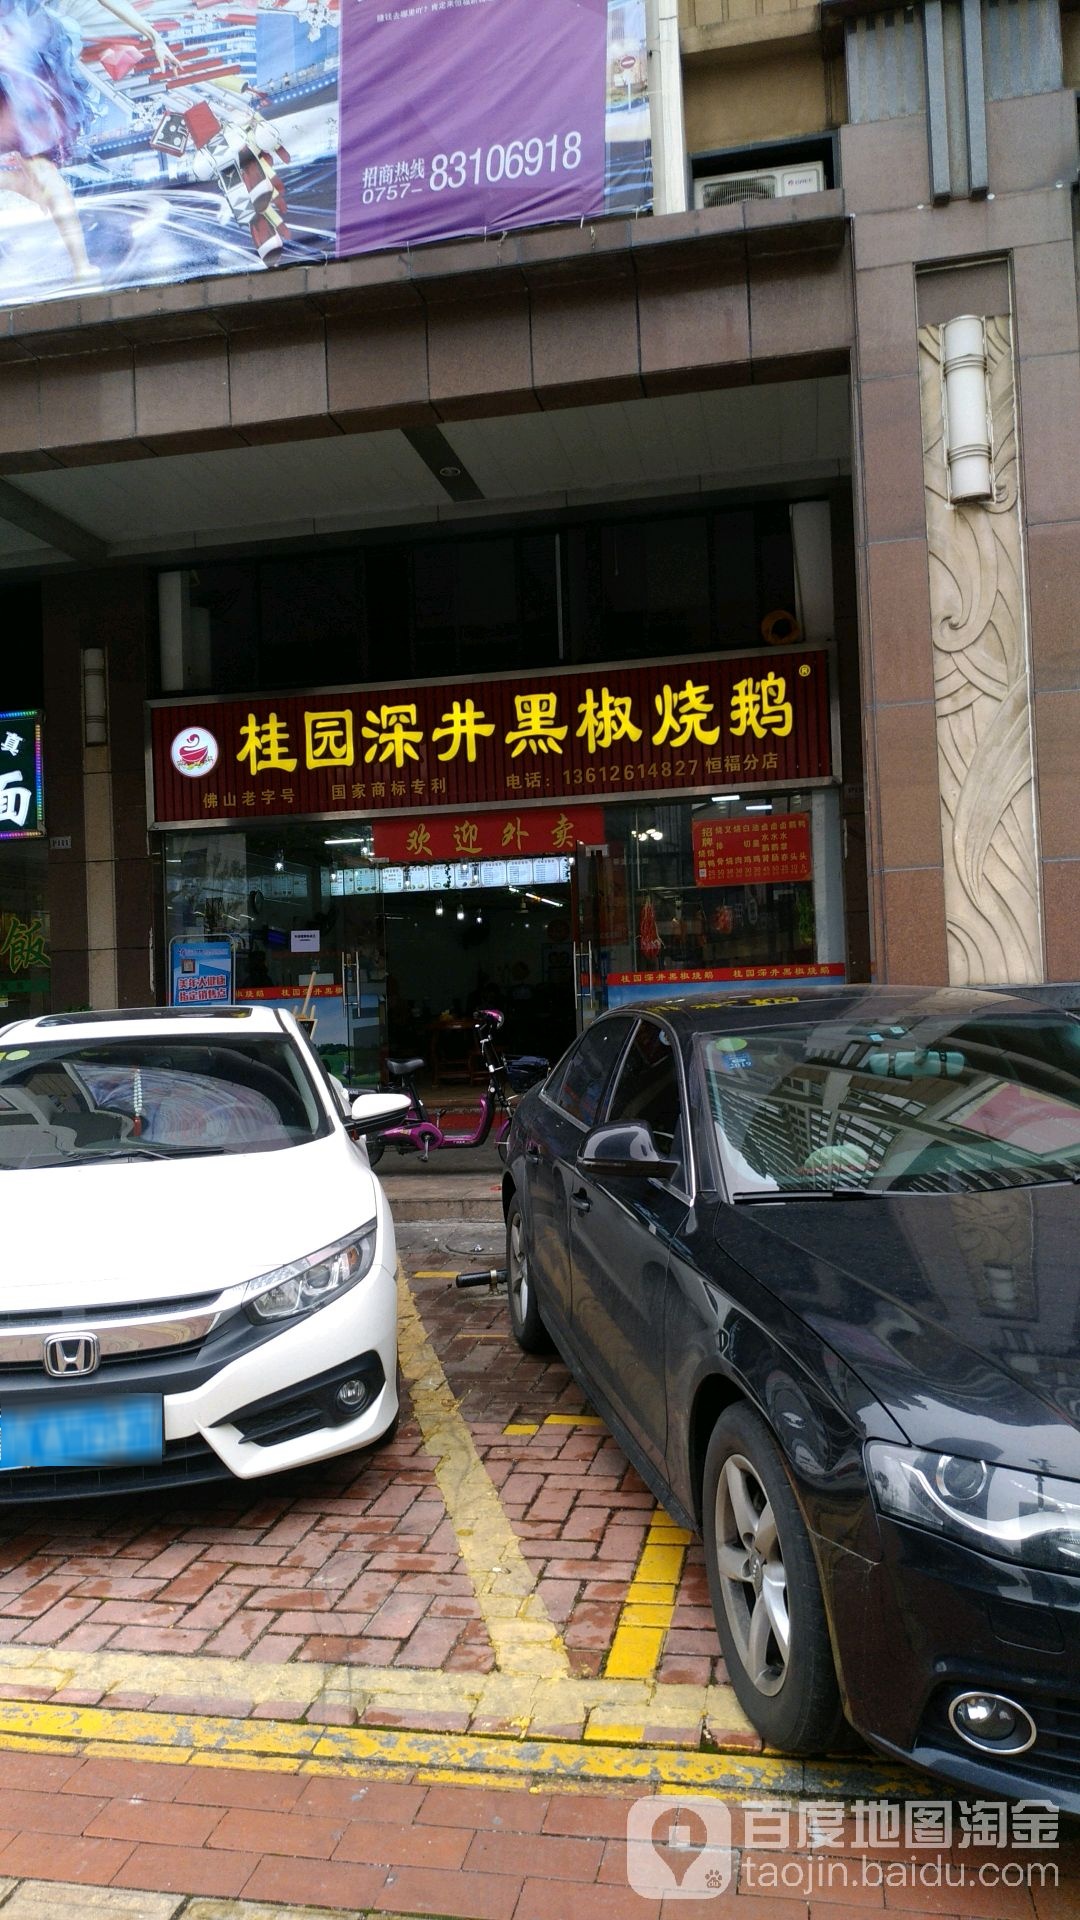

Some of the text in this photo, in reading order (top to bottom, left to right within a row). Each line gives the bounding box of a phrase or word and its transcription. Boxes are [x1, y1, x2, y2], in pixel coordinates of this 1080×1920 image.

[362, 158, 425, 189] 招商热线
[430, 131, 582, 191] 83106918
[236, 671, 794, 776] 桂园深井黑椒烧鹅
[563, 759, 699, 785] 13612614827
[705, 752, 779, 774] 恒福分店
[203, 777, 447, 809] 佛山老字号 国家商标专利
[406, 813, 575, 856] 欢迎外卖
